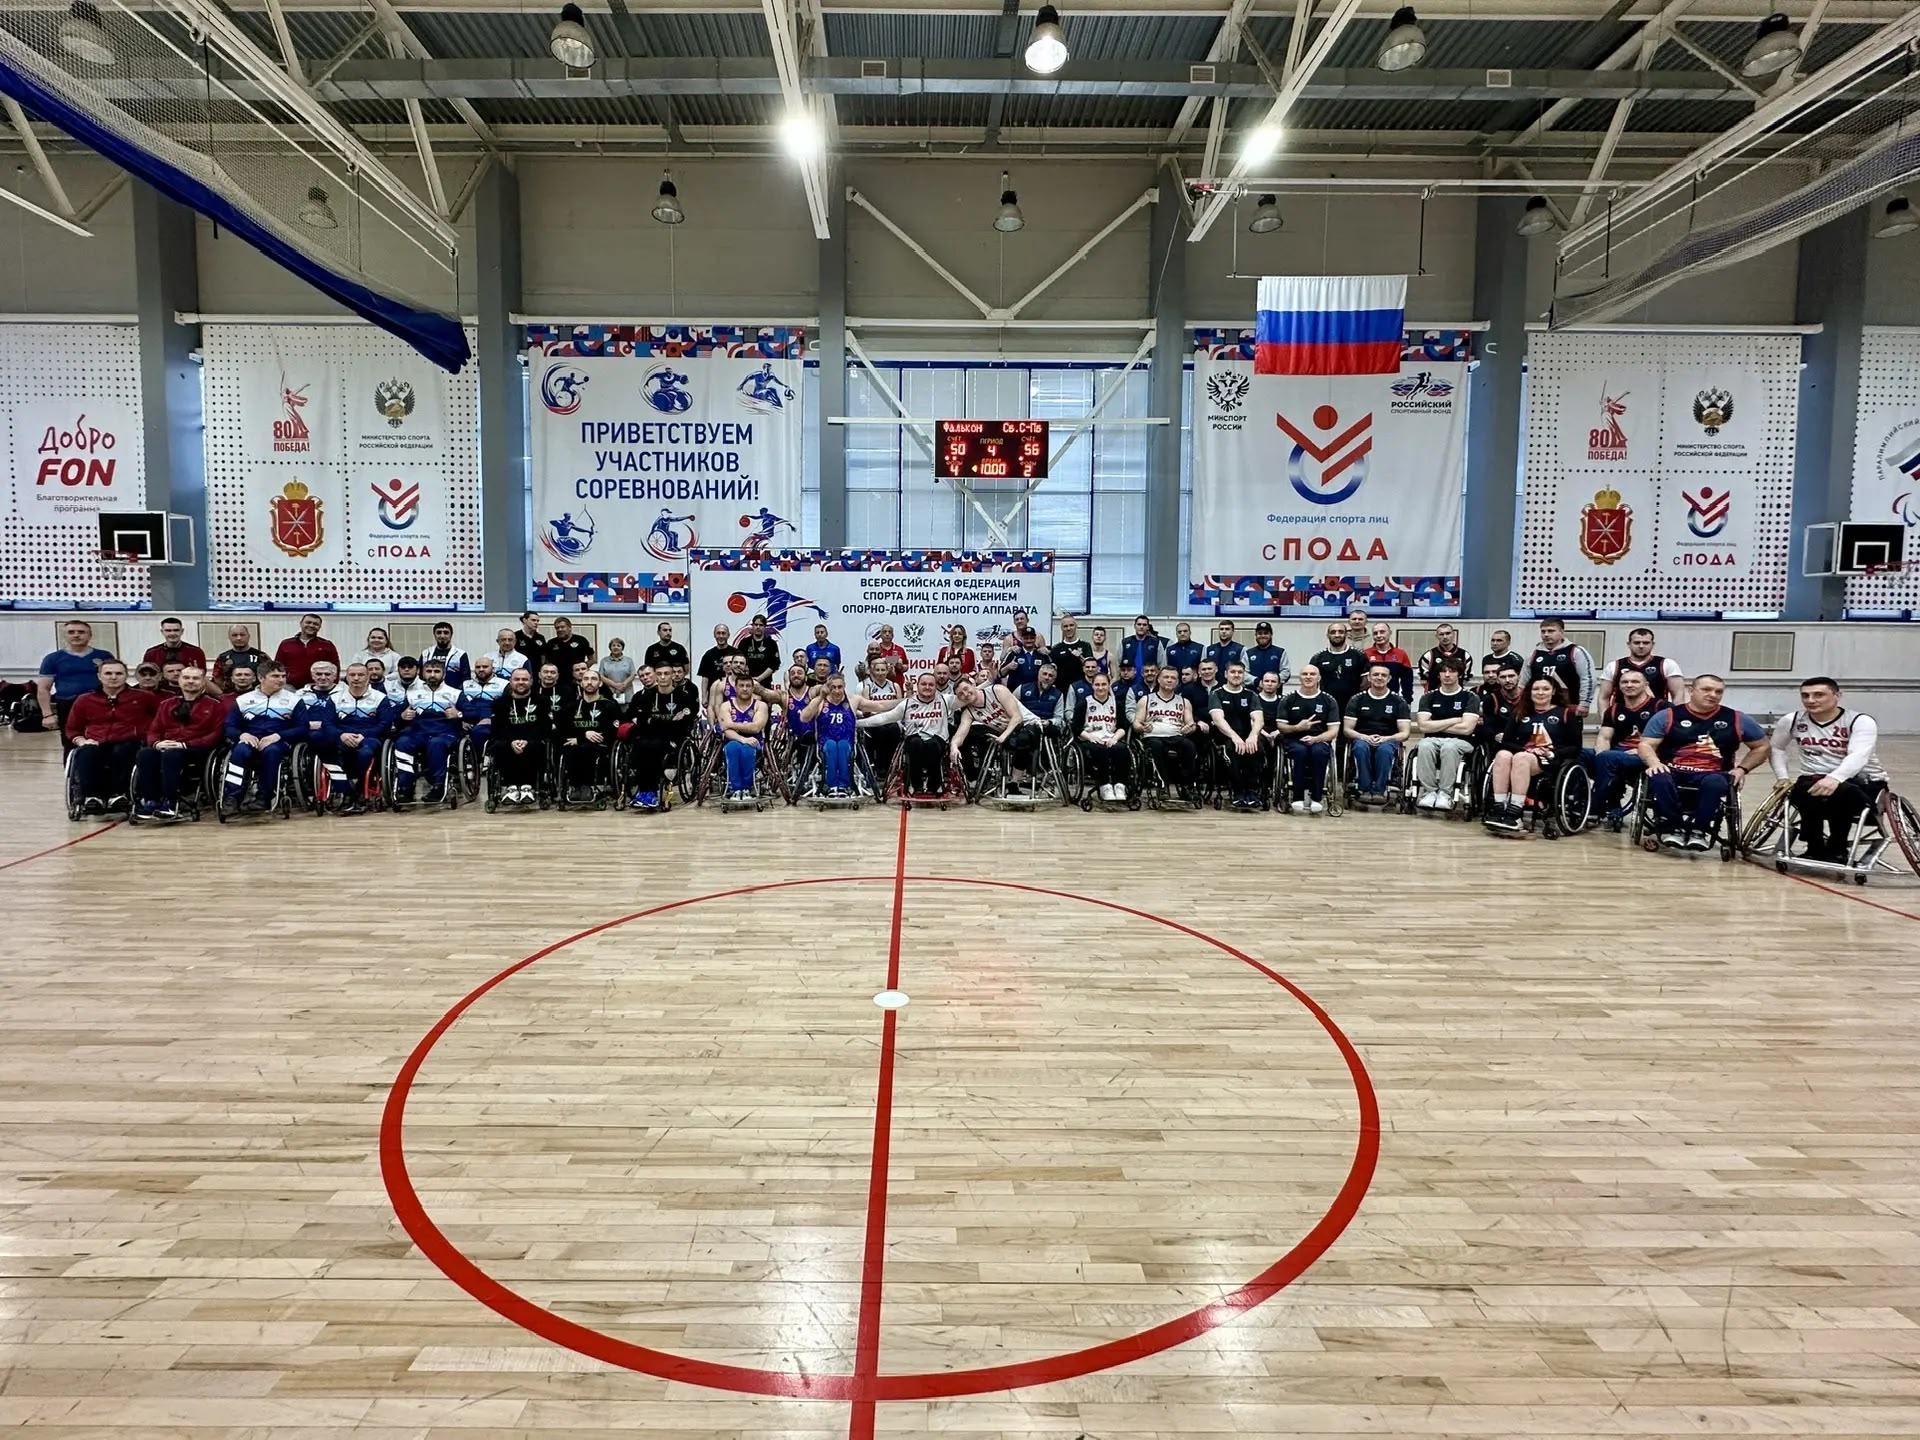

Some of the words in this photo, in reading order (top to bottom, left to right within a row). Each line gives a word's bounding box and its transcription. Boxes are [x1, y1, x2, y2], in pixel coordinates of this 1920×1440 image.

[1391, 400, 1452, 408] РОССИЙСКИЙ
[1207, 414, 1247, 422] МИНСПОРТ
[273, 420, 293, 439] 80
[1212, 423, 1243, 431] РОССИИ
[38, 413, 116, 455] Добро
[581, 422, 753, 445] ПРИВЕТСТВУЕМ
[1589, 428, 1610, 448] 80
[273, 442, 310, 453] ПОБЕДА!
[950, 443, 966, 455] 50
[987, 445, 996, 456] 4
[1024, 444, 1040, 455] 56
[1588, 450, 1627, 461] ПОБЕДА!
[595, 451, 740, 473] УЧАСТНИКОВ
[36, 458, 117, 487] FON
[950, 465, 959, 476] 4
[1023, 465, 1032, 477] 2
[575, 474, 759, 500] СОРЕВНОВАНИЙ!
[36, 494, 118, 502] Благотворительная
[1266, 513, 1326, 524] Федерация
[1329, 515, 1366, 524] спорта
[1368, 514, 1389, 524] лиц
[860, 576, 950, 589] ВСЕРОССИЙСКАЯ
[954, 577, 1020, 590] ФЕДЕРАЦИЯ
[863, 591, 904, 602] СПОРТА
[907, 591, 930, 604] ЛИЦ
[932, 591, 940, 602] С
[942, 590, 1018, 602] ПОРАЖЕНИЕМ
[842, 604, 979, 615] ОПОРНО-ДВИГАТЕЛЬНОГО
[829, 713, 843, 724] 78
